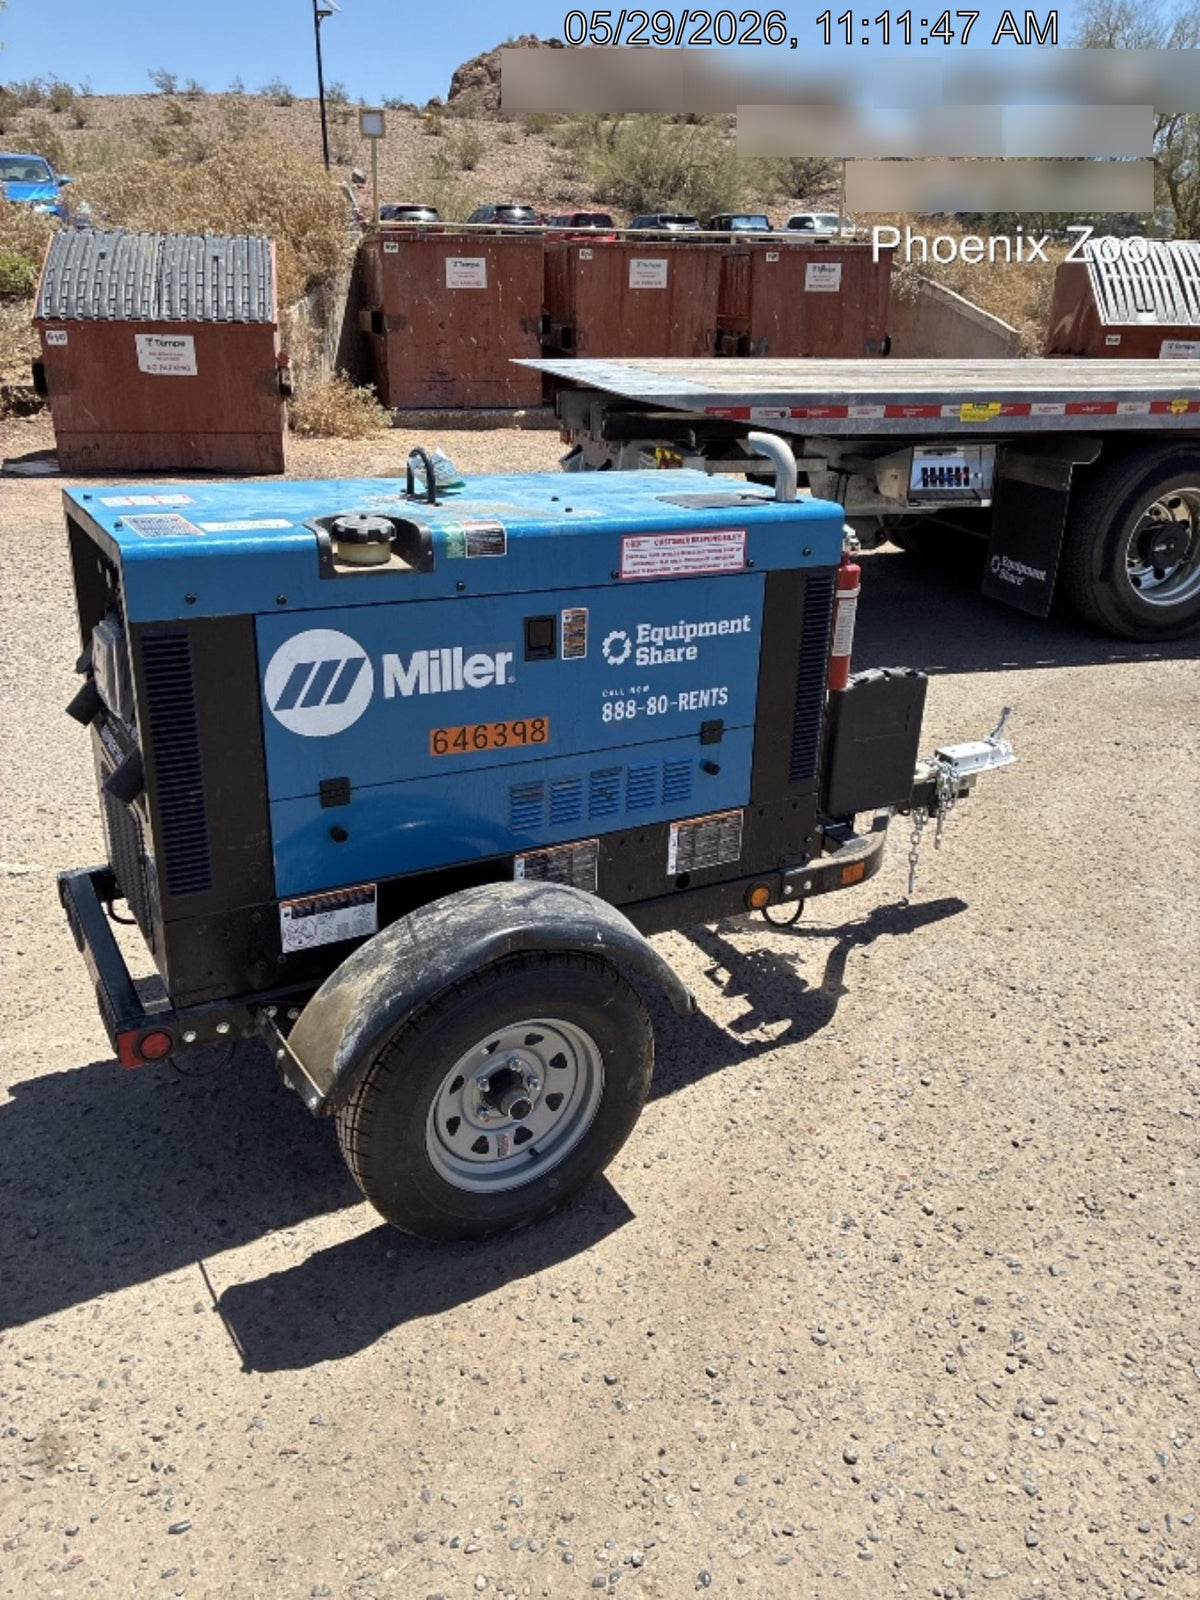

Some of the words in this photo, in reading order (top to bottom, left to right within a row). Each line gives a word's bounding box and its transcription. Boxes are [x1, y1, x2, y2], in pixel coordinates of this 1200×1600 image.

[636, 614, 751, 647] Equipment
[382, 646, 513, 699] Miller
[636, 645, 698, 667] Share
[602, 686, 728, 722] 888-80-RENTS
[432, 718, 546, 755] 646398
